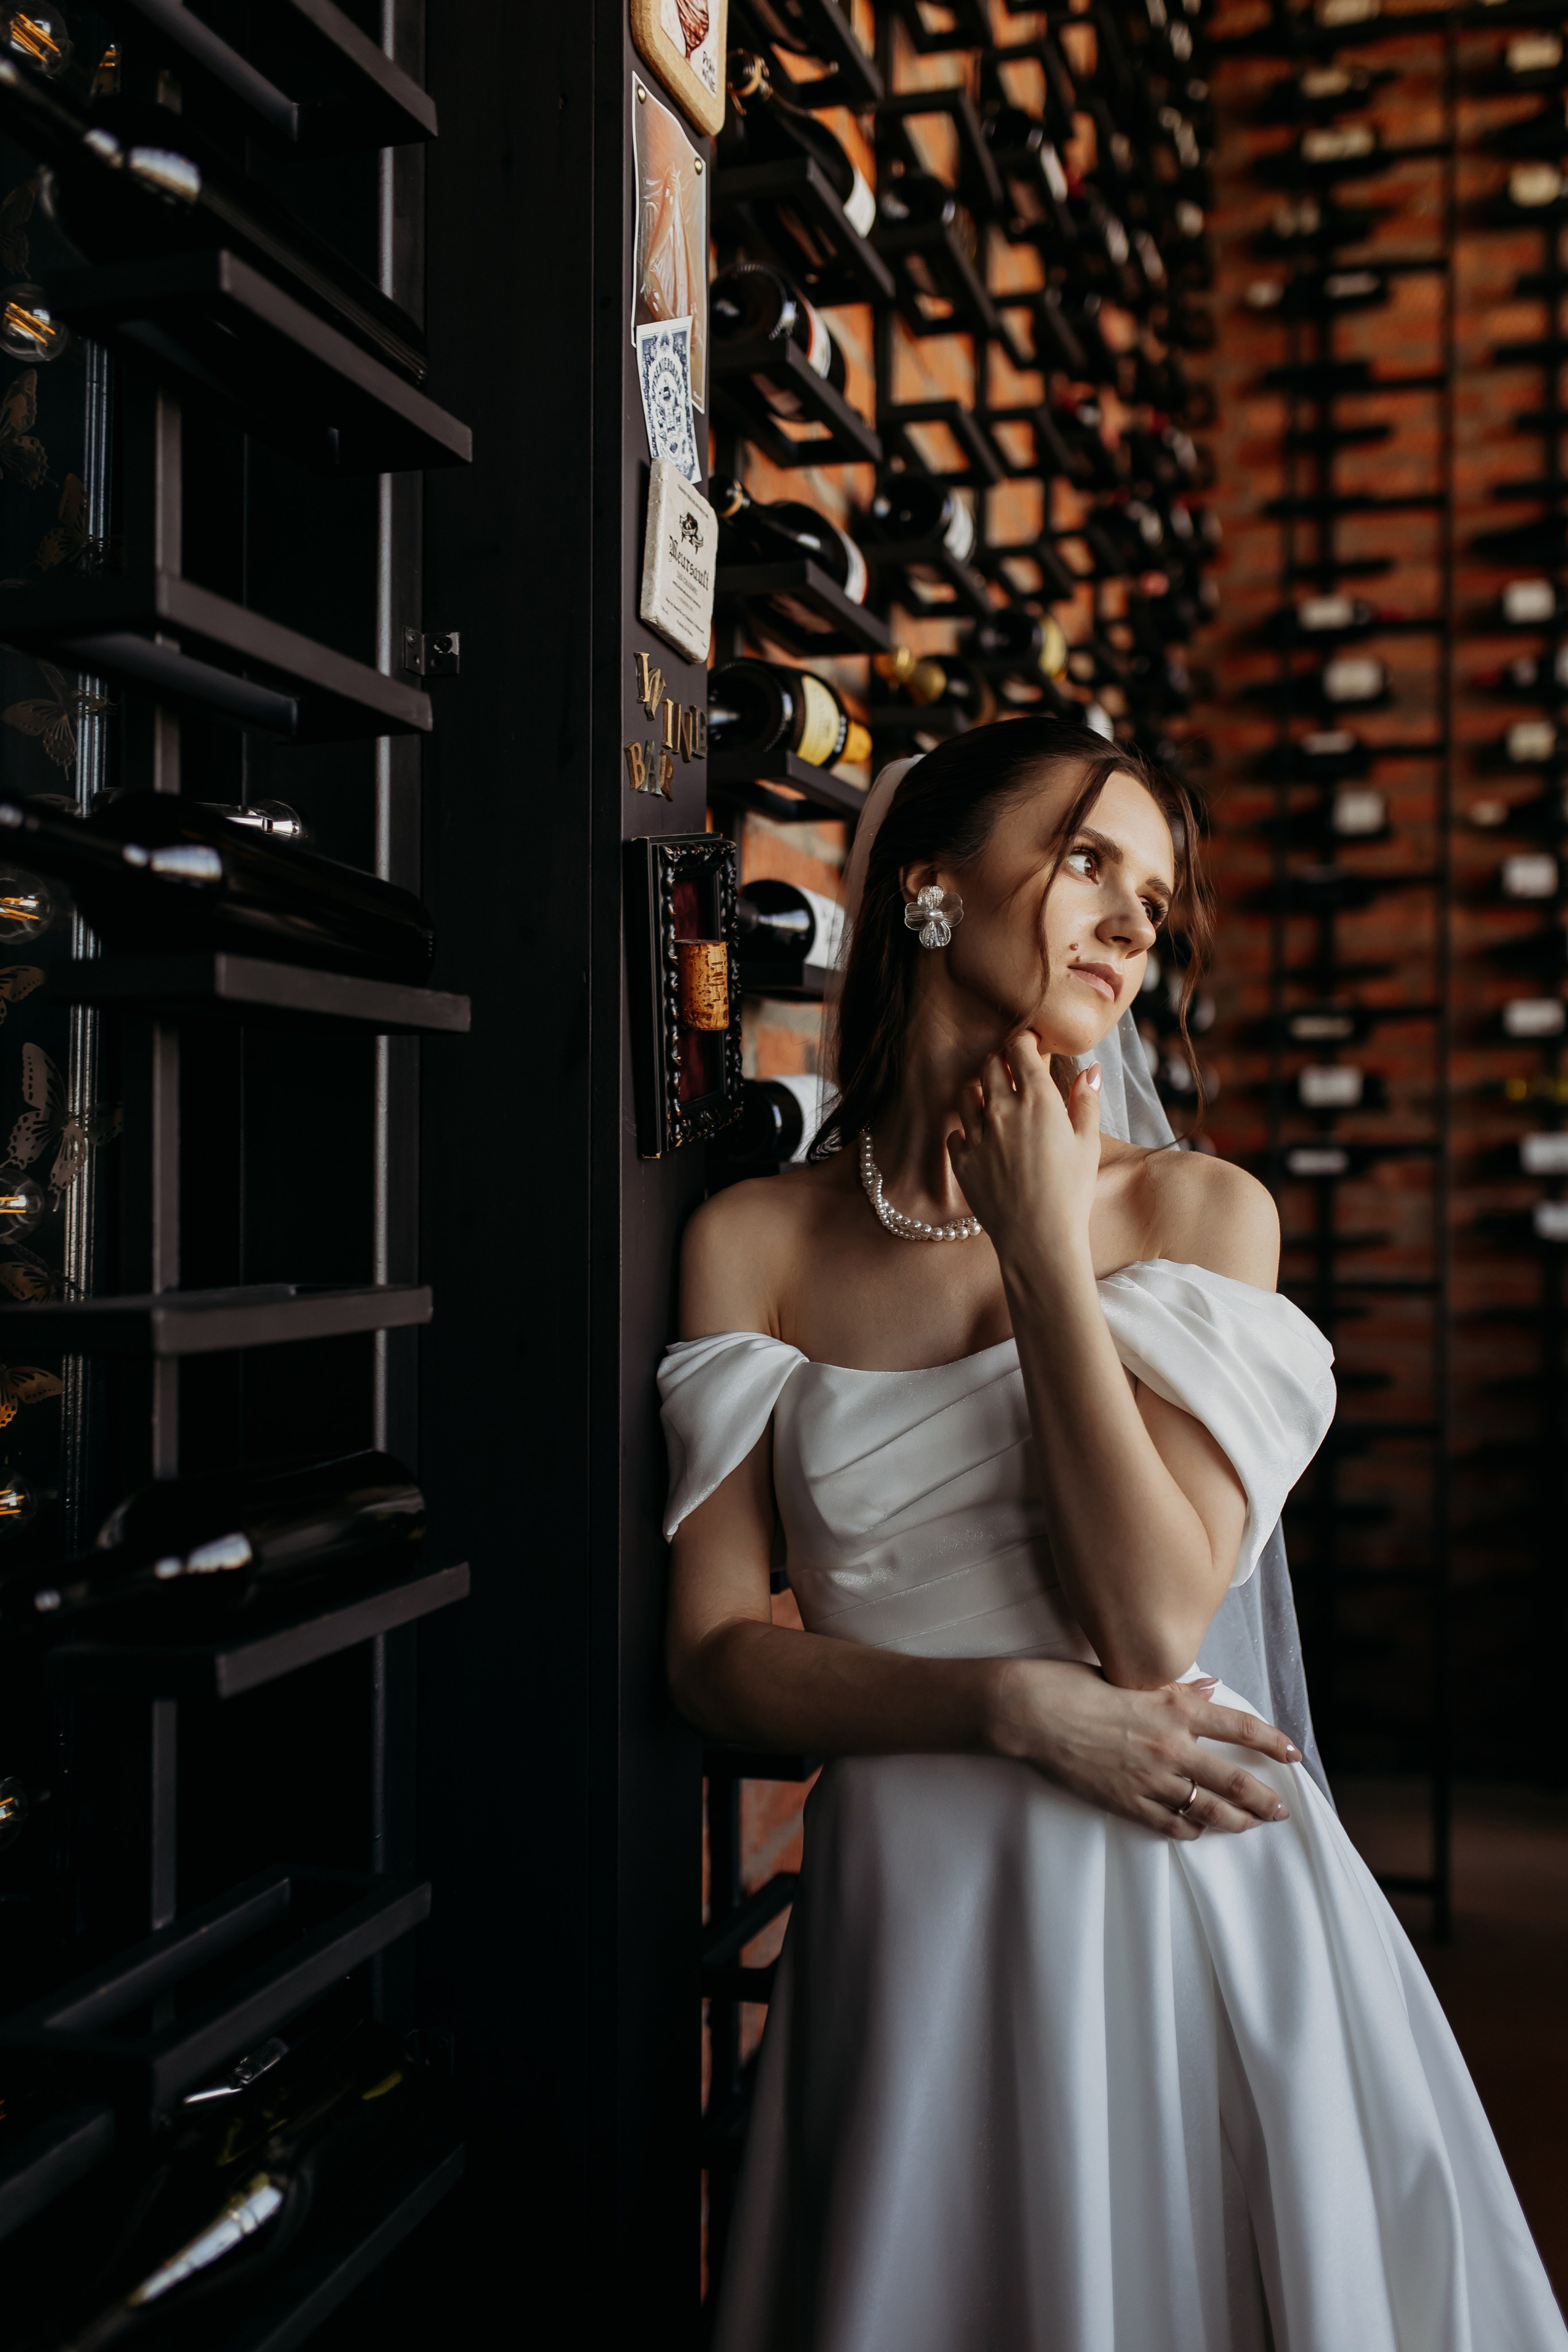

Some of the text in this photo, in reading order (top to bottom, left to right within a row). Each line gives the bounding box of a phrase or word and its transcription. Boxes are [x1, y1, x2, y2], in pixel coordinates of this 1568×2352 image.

[668, 535, 709, 590] Meursault
[633, 651, 707, 763] WINE
[624, 740, 673, 802] BAR
